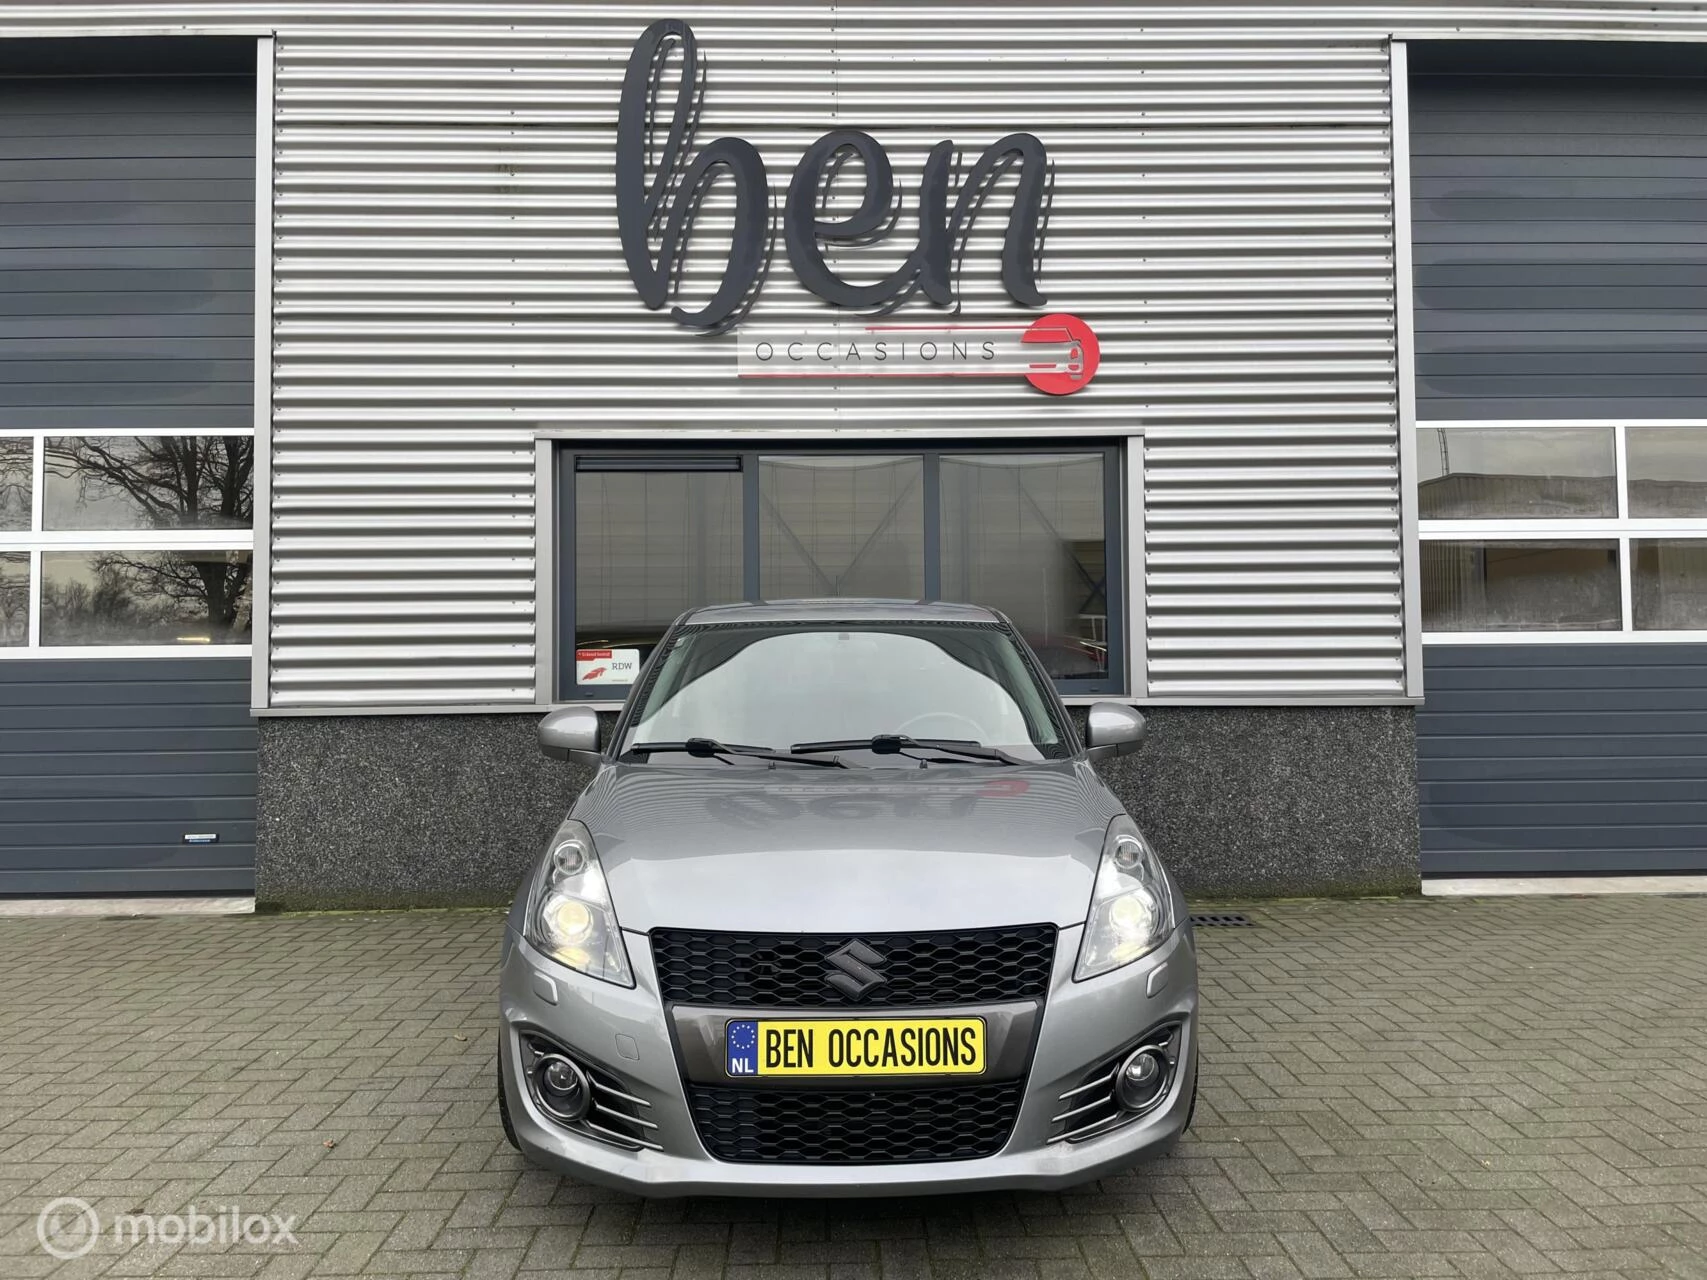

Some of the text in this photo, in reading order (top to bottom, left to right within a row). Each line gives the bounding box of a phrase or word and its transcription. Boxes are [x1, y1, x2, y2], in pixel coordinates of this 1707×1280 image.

[615, 18, 1048, 327] ben
[755, 341, 995, 361] OCCASIONS
[612, 662, 632, 670] RDW
[765, 1027, 976, 1068] BEN OCCASIONS
[731, 1058, 754, 1073] NL
